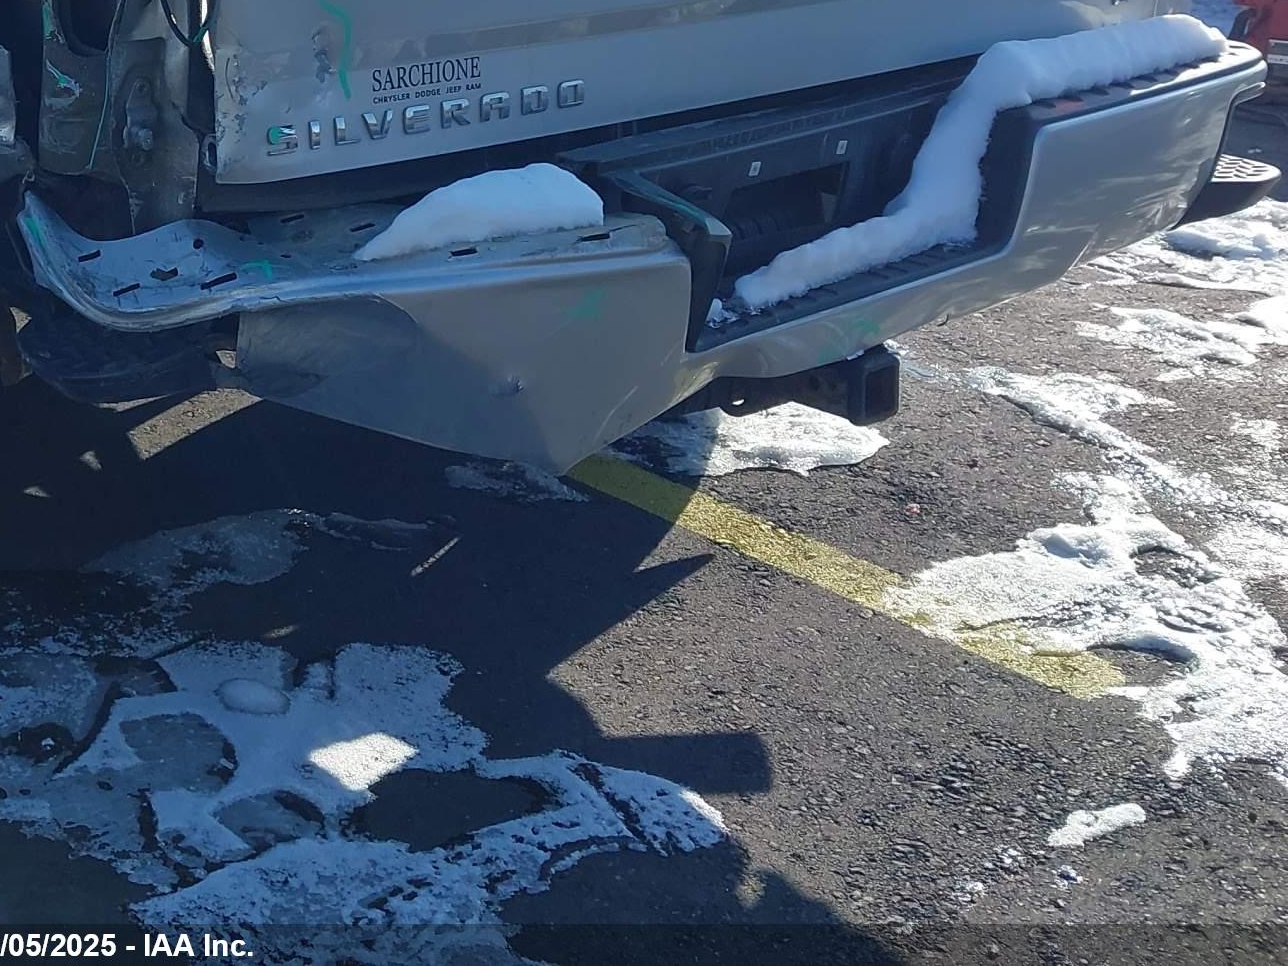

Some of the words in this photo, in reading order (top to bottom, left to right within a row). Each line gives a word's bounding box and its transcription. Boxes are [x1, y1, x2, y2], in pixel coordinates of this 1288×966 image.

[372, 56, 481, 92] SARCHIONE
[373, 92, 410, 104] CHRYSLER
[414, 88, 441, 99] DODGE
[446, 85, 462, 94] JEEP
[465, 83, 482, 91] RAM
[267, 79, 586, 157] SILVERADO
